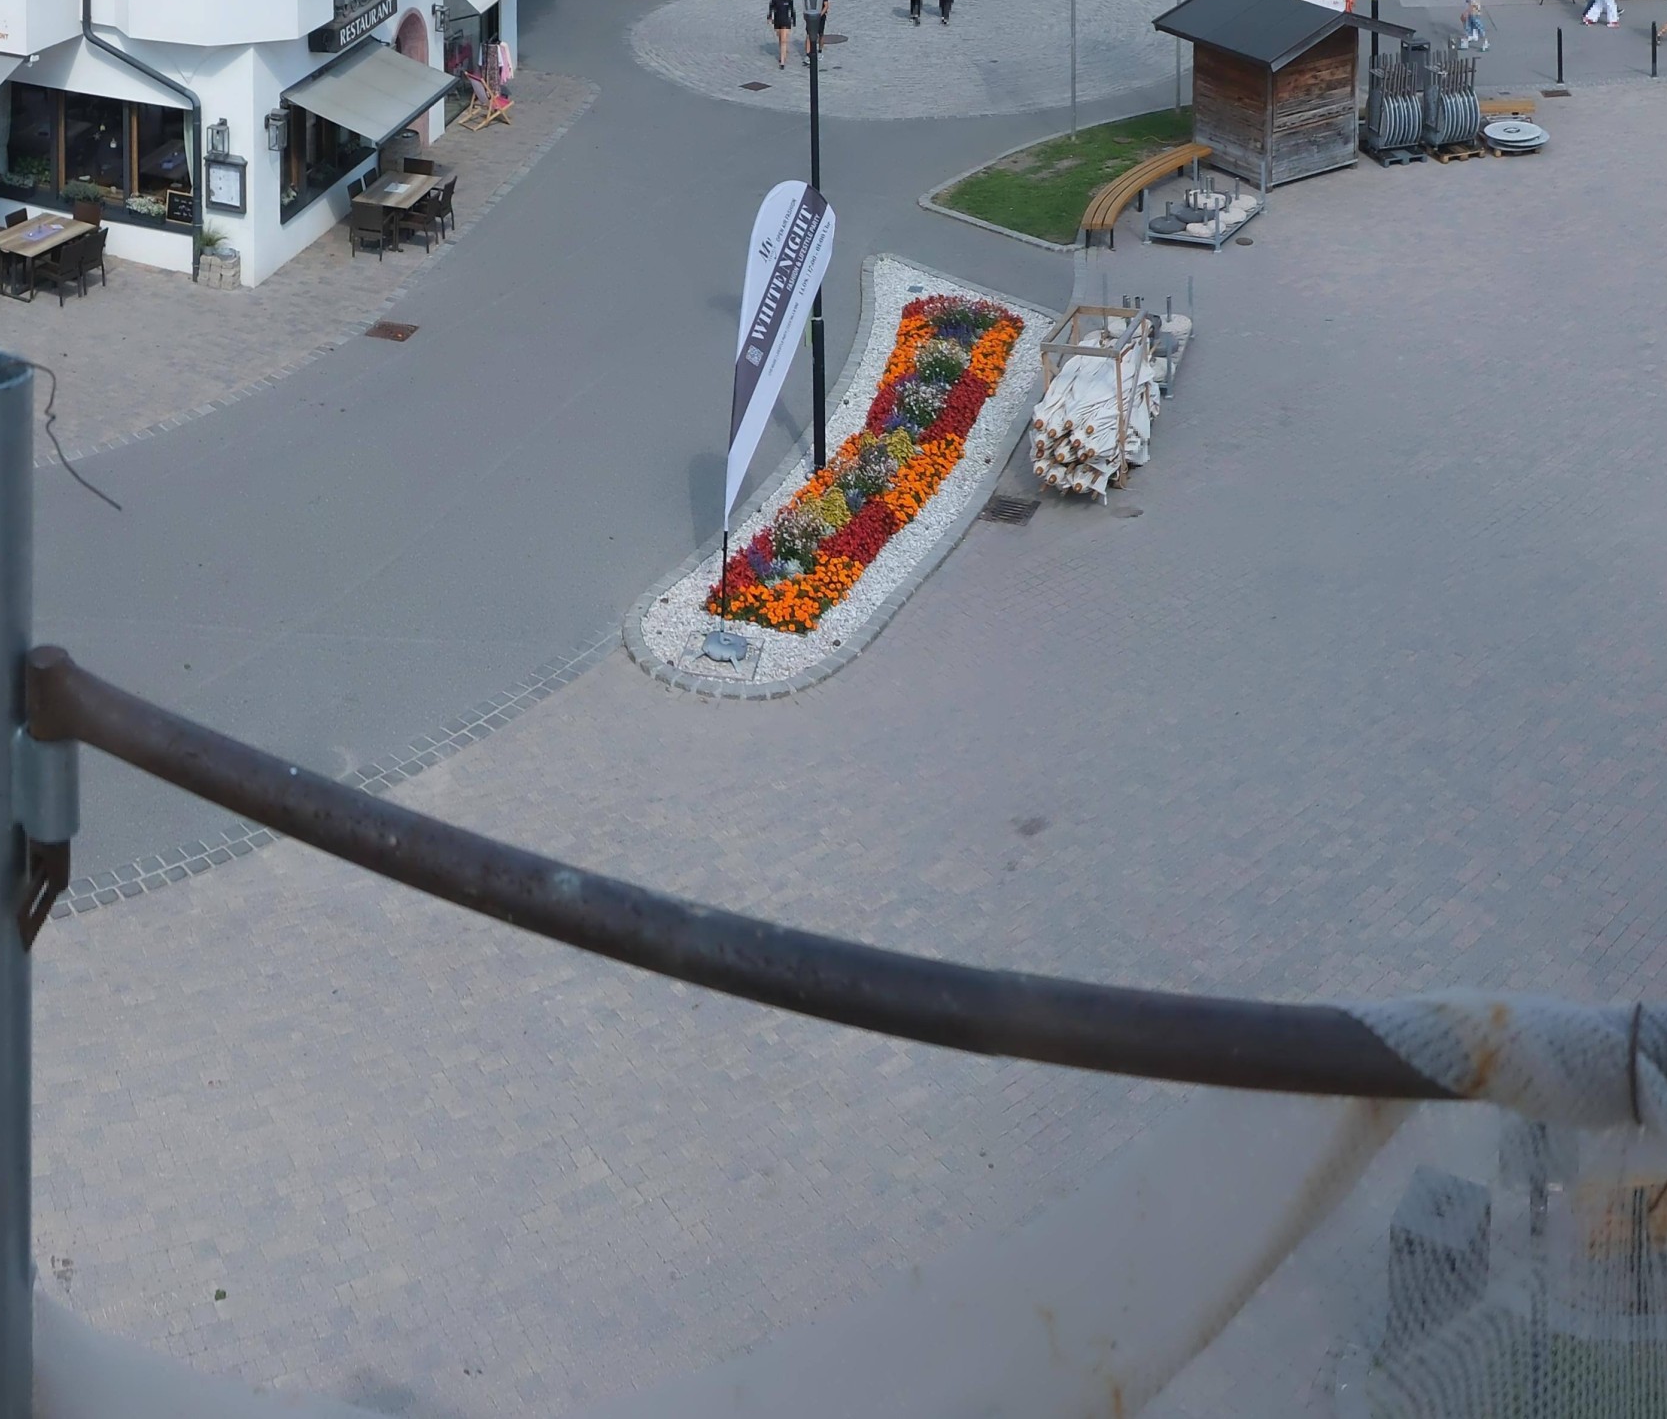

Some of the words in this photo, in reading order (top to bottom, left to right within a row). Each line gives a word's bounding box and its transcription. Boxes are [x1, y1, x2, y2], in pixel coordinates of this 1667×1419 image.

[808, 213, 821, 232] PARTY
[750, 272, 787, 339] WHITE
[778, 204, 814, 272] NIGHT
